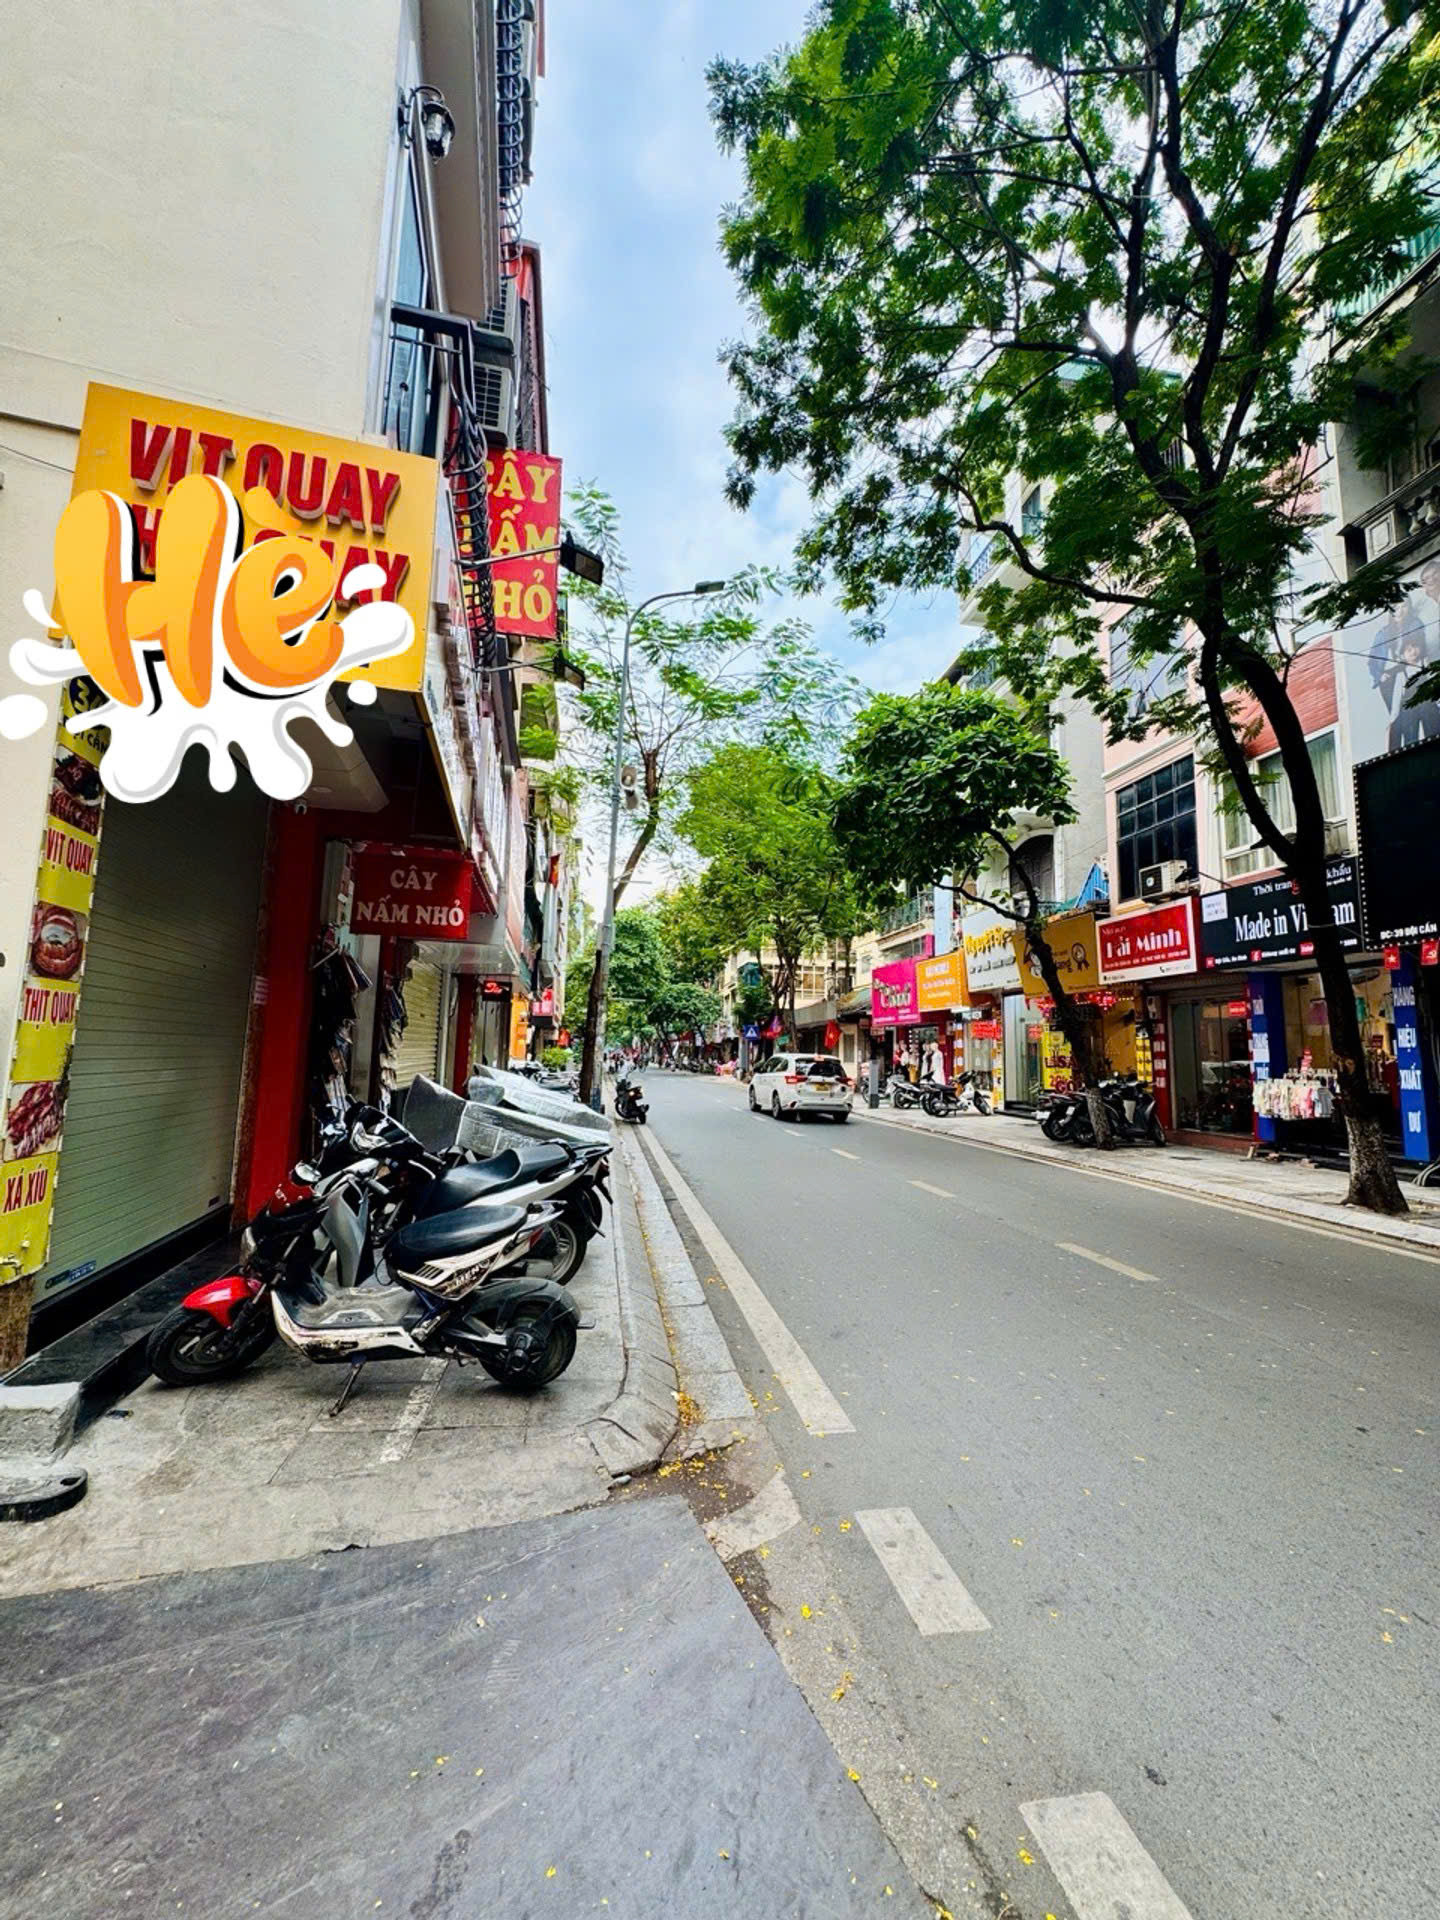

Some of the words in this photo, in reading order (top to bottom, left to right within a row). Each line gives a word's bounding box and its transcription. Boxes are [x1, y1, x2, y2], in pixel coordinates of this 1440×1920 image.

[243, 443, 401, 536] QUAY
[66, 837, 95, 876] QUAY
[390, 864, 438, 891] CÂY
[356, 895, 410, 924] NẤM
[415, 899, 465, 927] NHỎ
[1235, 909, 1271, 943] Made
[1274, 908, 1288, 935] in
[1136, 928, 1182, 952] Minh
[23, 988, 50, 1029] THỊT
[51, 990, 77, 1026] QUAY
[1394, 983, 1415, 1007] HÀNG
[1398, 1024, 1416, 1053] HIỆU
[1400, 1063, 1422, 1091] XUẤT
[3, 1168, 24, 1213] XÁ
[25, 1164, 48, 1207] XÍU
